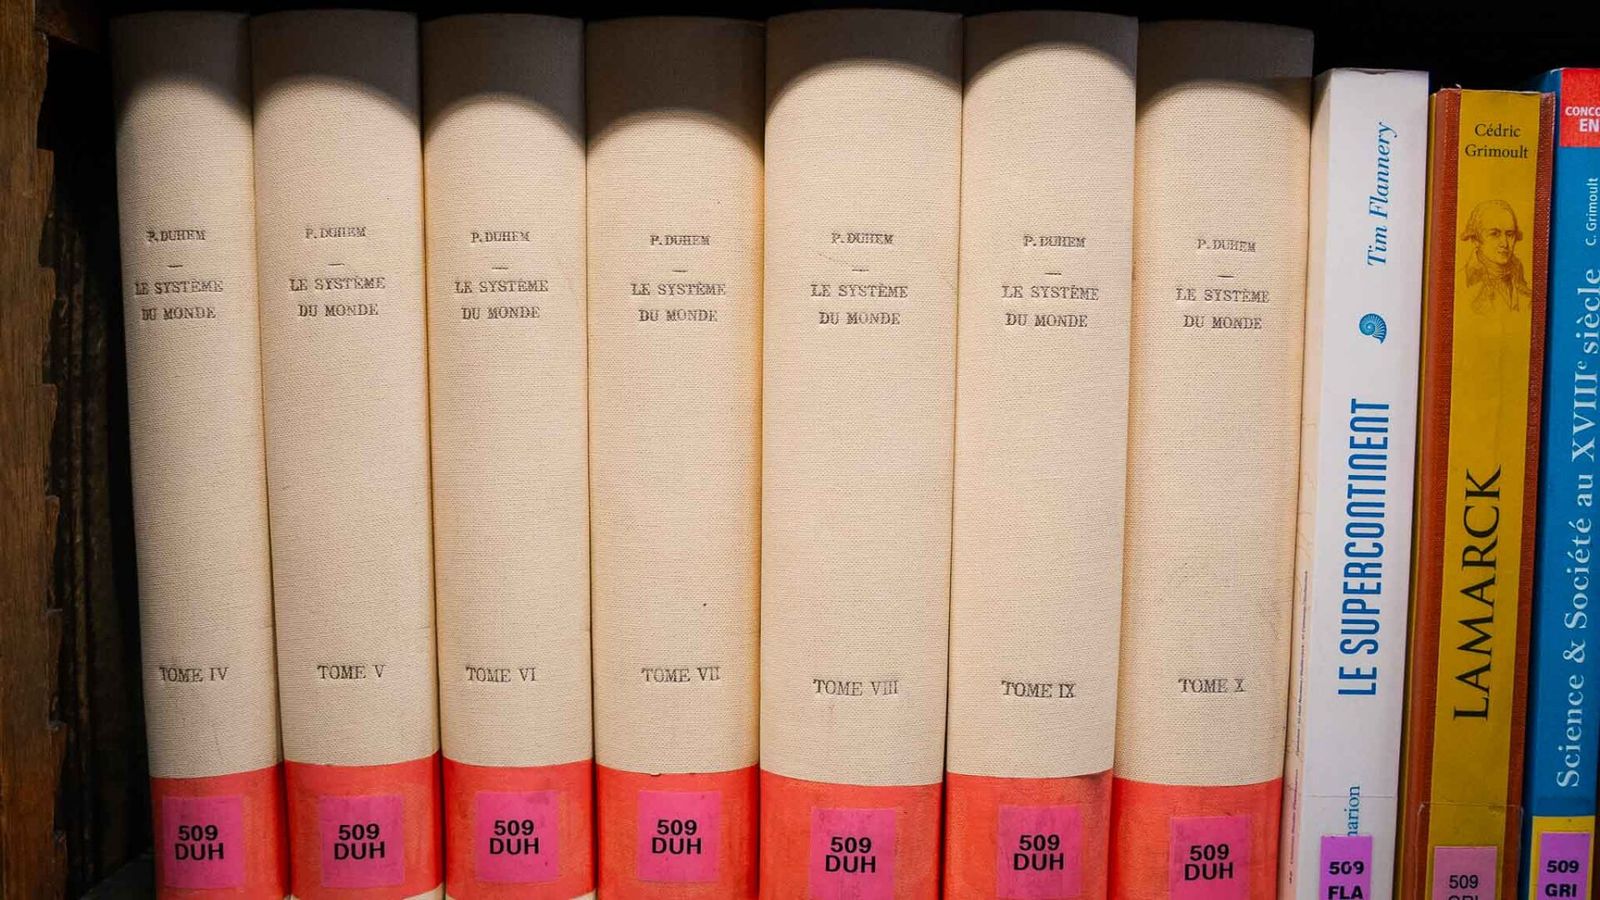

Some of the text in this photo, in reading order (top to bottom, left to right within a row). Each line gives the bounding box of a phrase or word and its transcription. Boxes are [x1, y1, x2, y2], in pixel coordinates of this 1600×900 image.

[1475, 123, 1521, 139] Cédric
[1465, 144, 1529, 159] Grimoult
[1367, 121, 1398, 266] Tim Flannery
[1585, 177, 1598, 246] C. Grimoult
[134, 278, 223, 295] LE SYSTÈME
[289, 276, 386, 291] LE SYSTÈME
[454, 278, 549, 294] LE SYSTÈME
[630, 281, 726, 296] LE SYSTÈME
[810, 282, 908, 298] LE SYSTÈME
[1002, 284, 1099, 301] LE SYSTÈME
[1176, 288, 1269, 303] LE SYSTÈME
[141, 306, 216, 320] DU MONDE
[299, 304, 379, 317] DU MONDE
[462, 306, 540, 319] DU MONDE
[639, 310, 718, 322] DU MONDE
[819, 312, 900, 325] DU MONDE
[1576, 268, 1600, 354] siècle
[1005, 313, 1088, 328] DU MONDE
[1184, 315, 1262, 329] DU MONDE
[1578, 473, 1594, 507] au
[1338, 397, 1389, 696] LE SUPERCONTINENT
[1564, 517, 1593, 629] Société
[1453, 465, 1502, 721] LAMARCK
[1563, 639, 1586, 663] &
[160, 666, 229, 682] TOME IV
[318, 664, 386, 680] TOME V
[466, 667, 536, 682] TOME VI
[641, 667, 720, 683] TOME VII
[813, 679, 898, 696] TOME VIII
[1001, 680, 1077, 698] TOME IX
[1179, 677, 1245, 694] TOME X
[1556, 675, 1585, 787] Science
[178, 825, 219, 842] 509
[338, 823, 380, 840] 509
[493, 820, 535, 837] 509
[656, 819, 698, 836] 509
[175, 843, 224, 860] DUH
[333, 842, 386, 860] DUH
[489, 838, 539, 855] DUH
[651, 838, 702, 855] DUH
[830, 836, 872, 853] 509
[1019, 835, 1060, 851] 509
[1190, 844, 1229, 861] 509
[825, 855, 876, 873] DUH
[1013, 853, 1064, 871] DUH
[1329, 861, 1364, 874] 509
[1547, 860, 1579, 872] 509
[1184, 863, 1233, 881] DUH
[1449, 875, 1479, 889] 509
[1545, 884, 1577, 897] GRI
[1328, 886, 1363, 900] FLA
